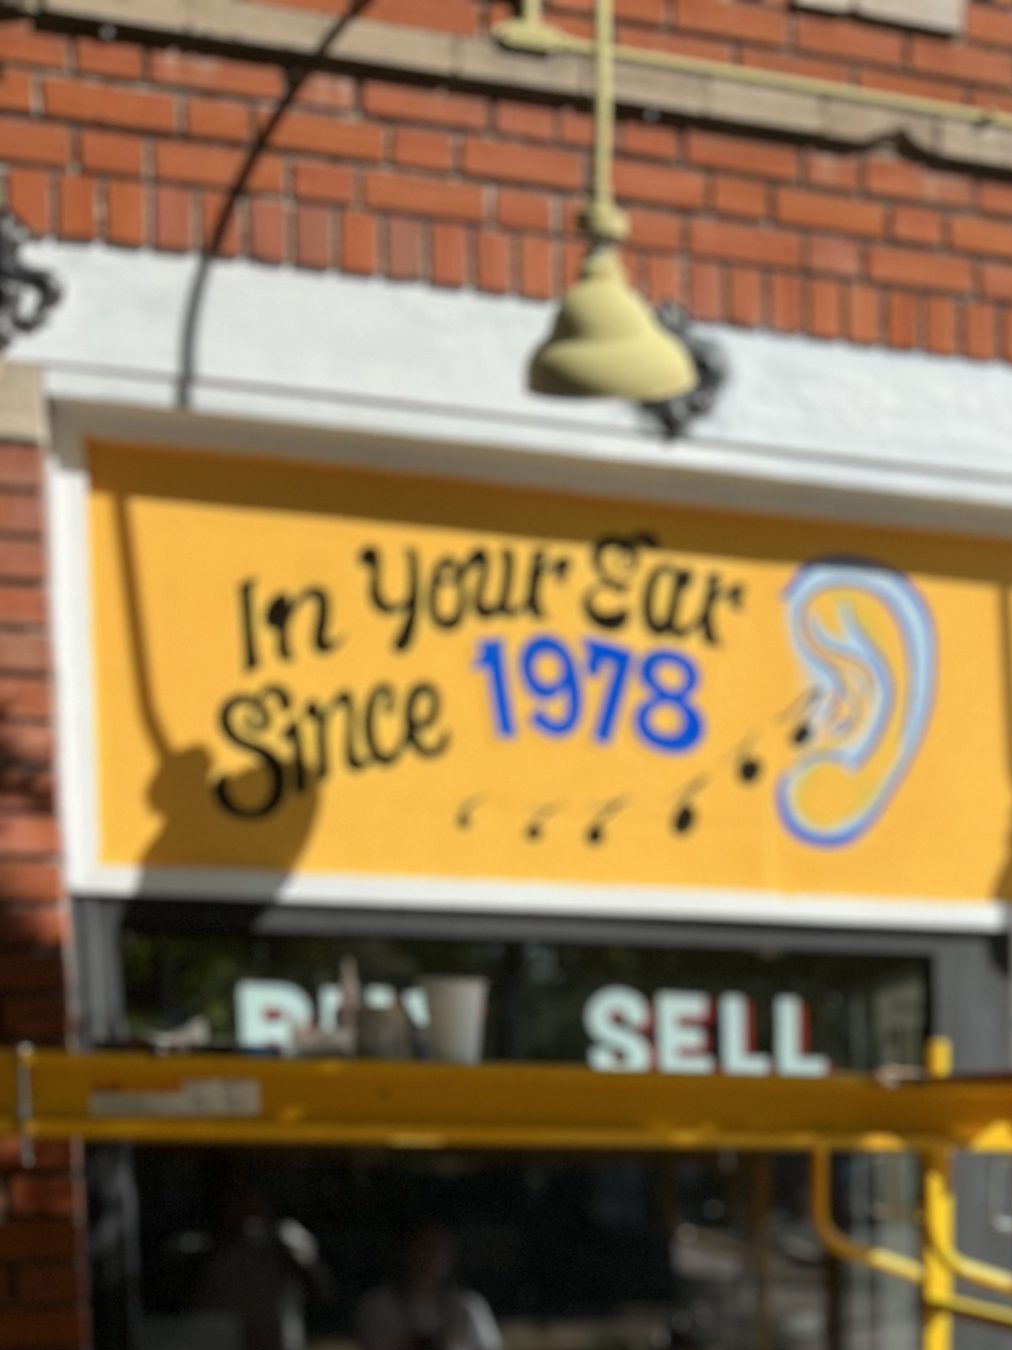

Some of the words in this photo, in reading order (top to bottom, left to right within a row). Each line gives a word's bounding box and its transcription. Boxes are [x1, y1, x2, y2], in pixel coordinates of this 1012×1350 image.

[236, 576, 345, 672] In
[580, 530, 748, 648] Ear
[210, 681, 454, 822] Since
[470, 632, 708, 756] 1978
[583, 983, 832, 1078] SELL
